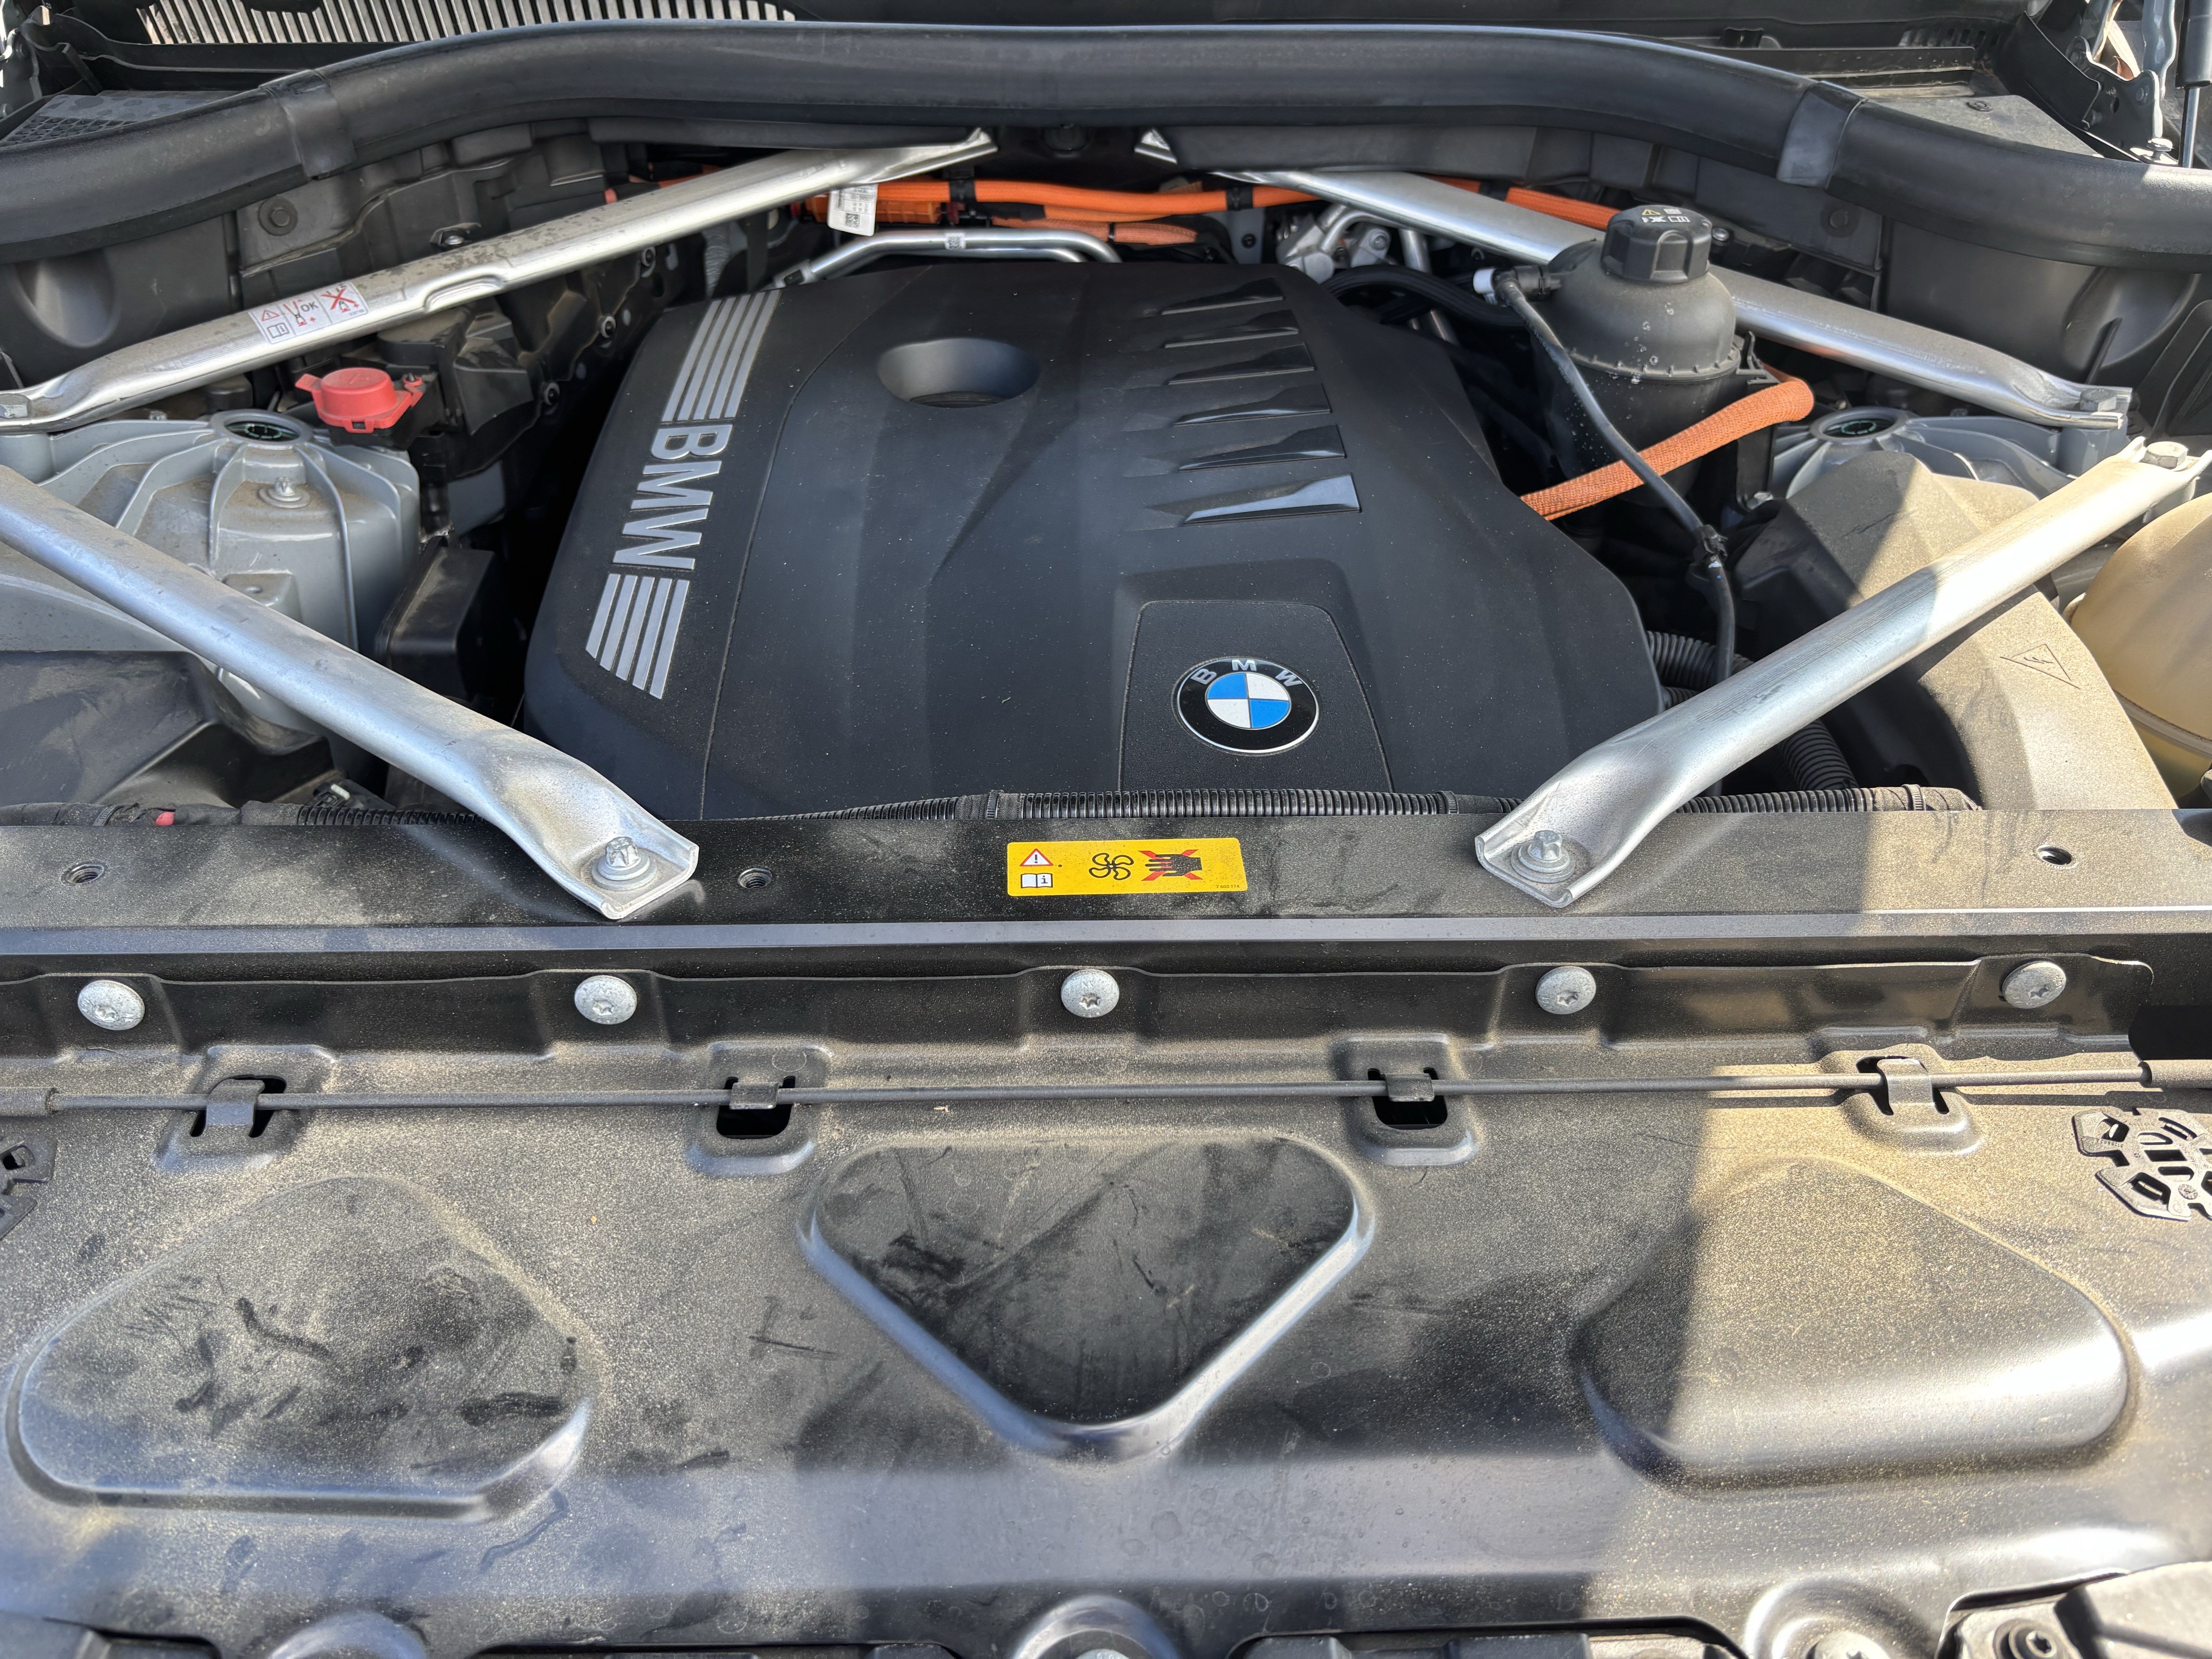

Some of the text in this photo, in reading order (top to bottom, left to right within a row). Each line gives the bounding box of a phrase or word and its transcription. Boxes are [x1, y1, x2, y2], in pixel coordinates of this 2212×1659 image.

[300, 301, 319, 312] OK
[613, 424, 733, 570] BMW
[1190, 659, 1304, 687] BMW
